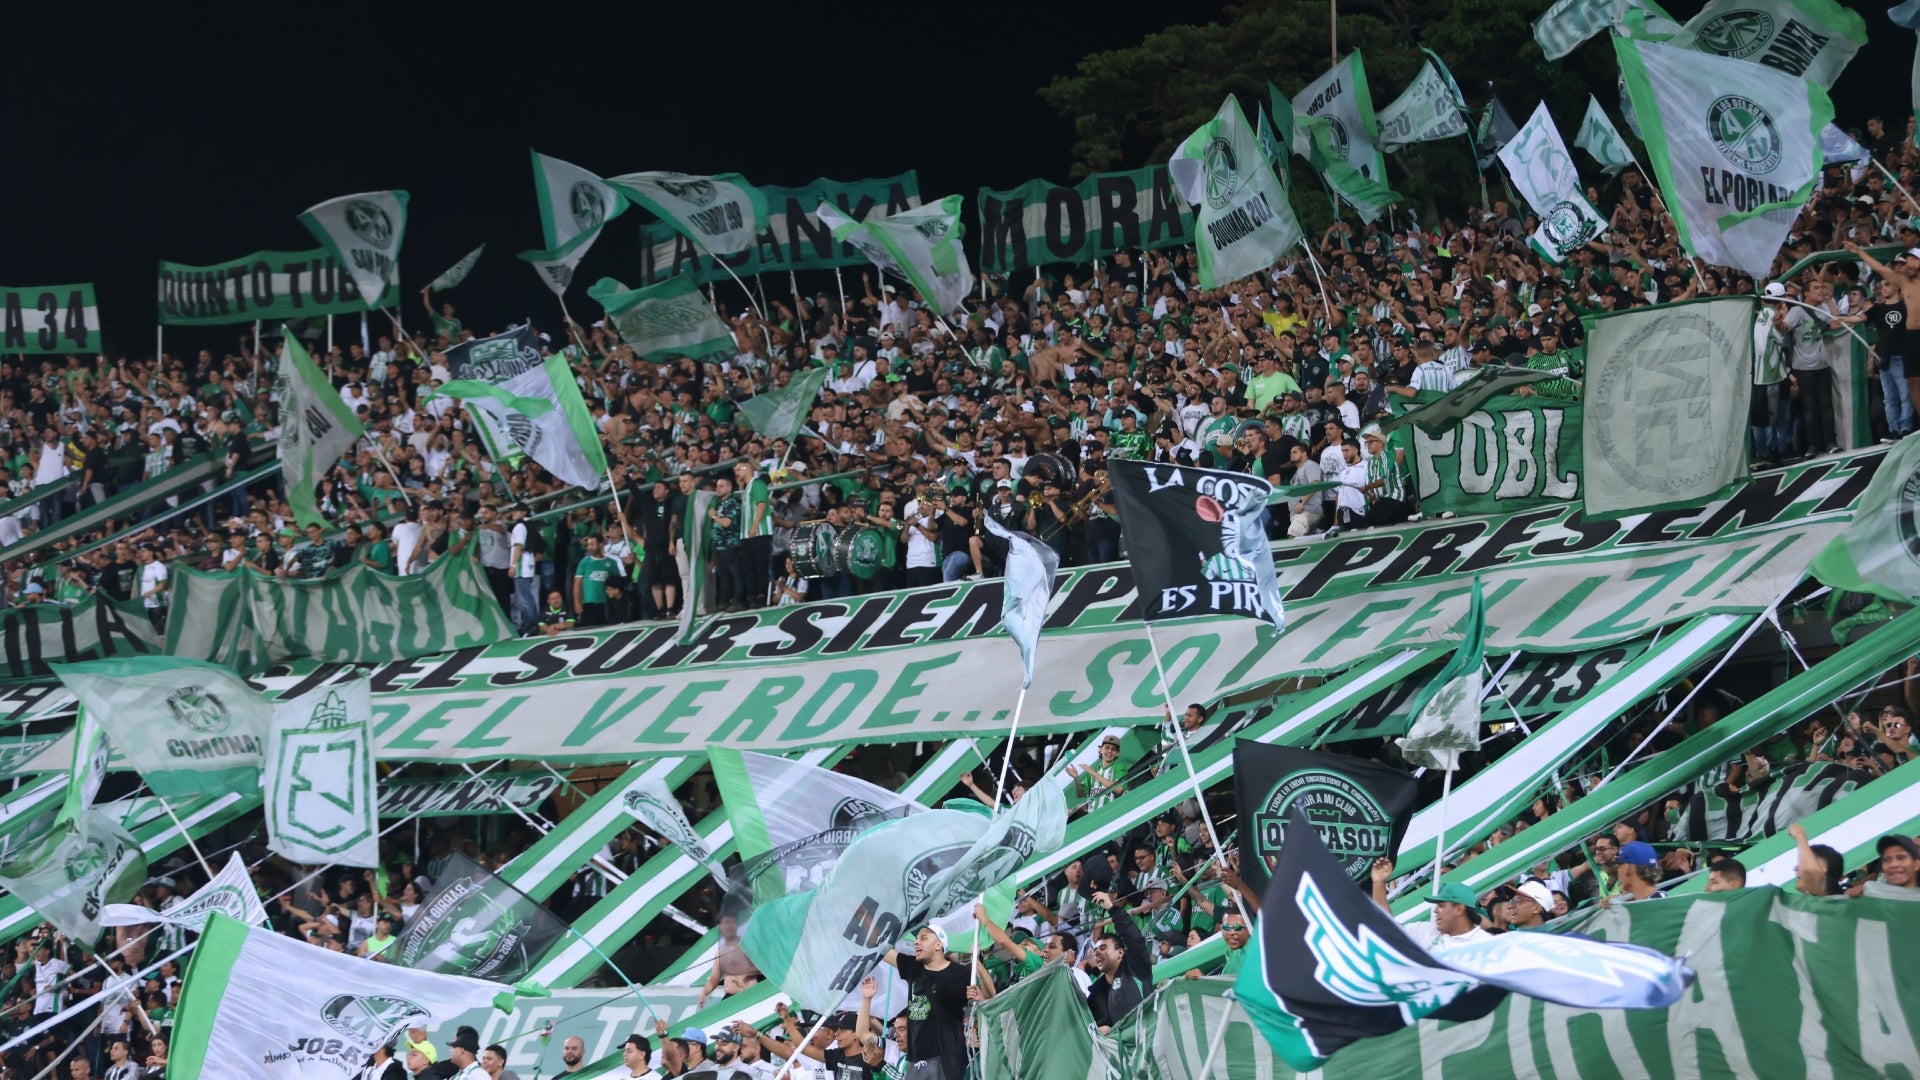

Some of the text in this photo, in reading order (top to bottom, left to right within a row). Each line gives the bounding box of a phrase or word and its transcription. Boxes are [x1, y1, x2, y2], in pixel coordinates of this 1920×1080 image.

[1716, 98, 1765, 120] LOS DEL SUR
[1701, 166, 1723, 204] EL
[161, 261, 273, 317] QUINTO
[283, 256, 391, 312] TUB
[5, 290, 88, 351] A 34
[1144, 467, 1185, 494] LA
[268, 643, 497, 703] DEL
[488, 612, 763, 687] SUR
[1283, 449, 1892, 601] PRESENT
[1158, 584, 1197, 614] ES
[516, 774, 557, 808] 3
[1269, 793, 1285, 813] TODA
[1281, 785, 1292, 796] LA
[1316, 793, 1323, 804] A
[1324, 793, 1334, 805] MI
[1335, 798, 1357, 817] CLUB
[1266, 821, 1386, 852] QASOL
[1346, 857, 1367, 876] OMBO
[479, 1004, 564, 1066] DE
